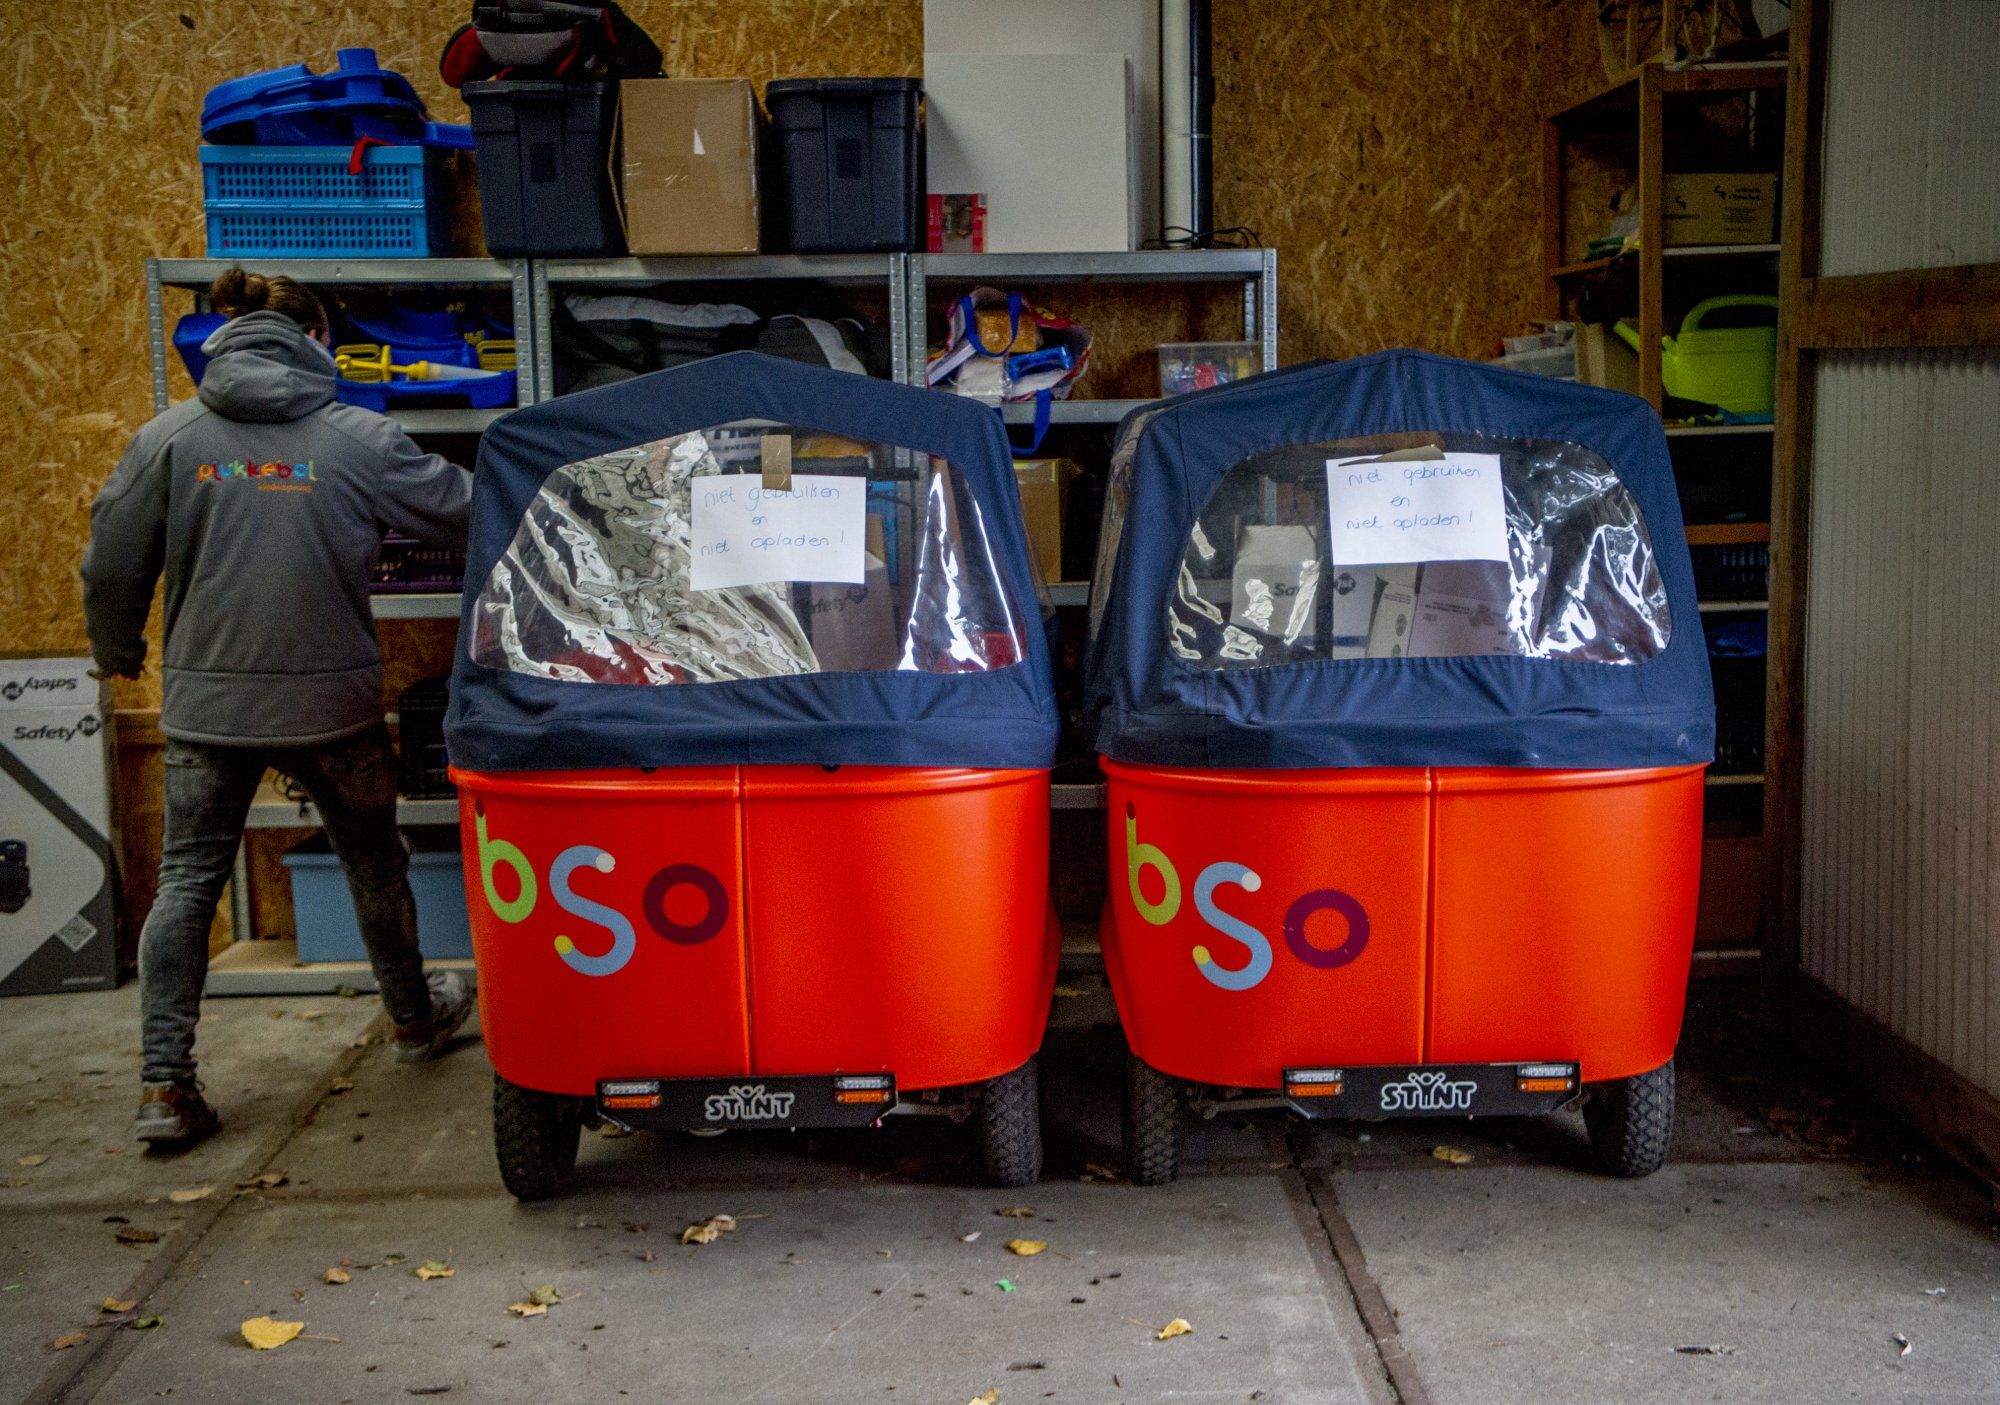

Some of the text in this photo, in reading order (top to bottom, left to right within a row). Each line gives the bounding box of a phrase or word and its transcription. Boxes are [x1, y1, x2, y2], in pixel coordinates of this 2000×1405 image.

[197, 459, 319, 483] plukkebol
[1348, 464, 1481, 487] niet gebruiken
[704, 486, 736, 508] niet
[1389, 496, 1411, 507] en
[751, 515, 768, 526] en
[1393, 513, 1460, 531] opladen
[700, 539, 730, 556] niet
[750, 533, 830, 551] opladen
[14, 725, 78, 741] Safety
[1381, 1072, 1477, 1110] STINT
[705, 1085, 795, 1120] STINT
